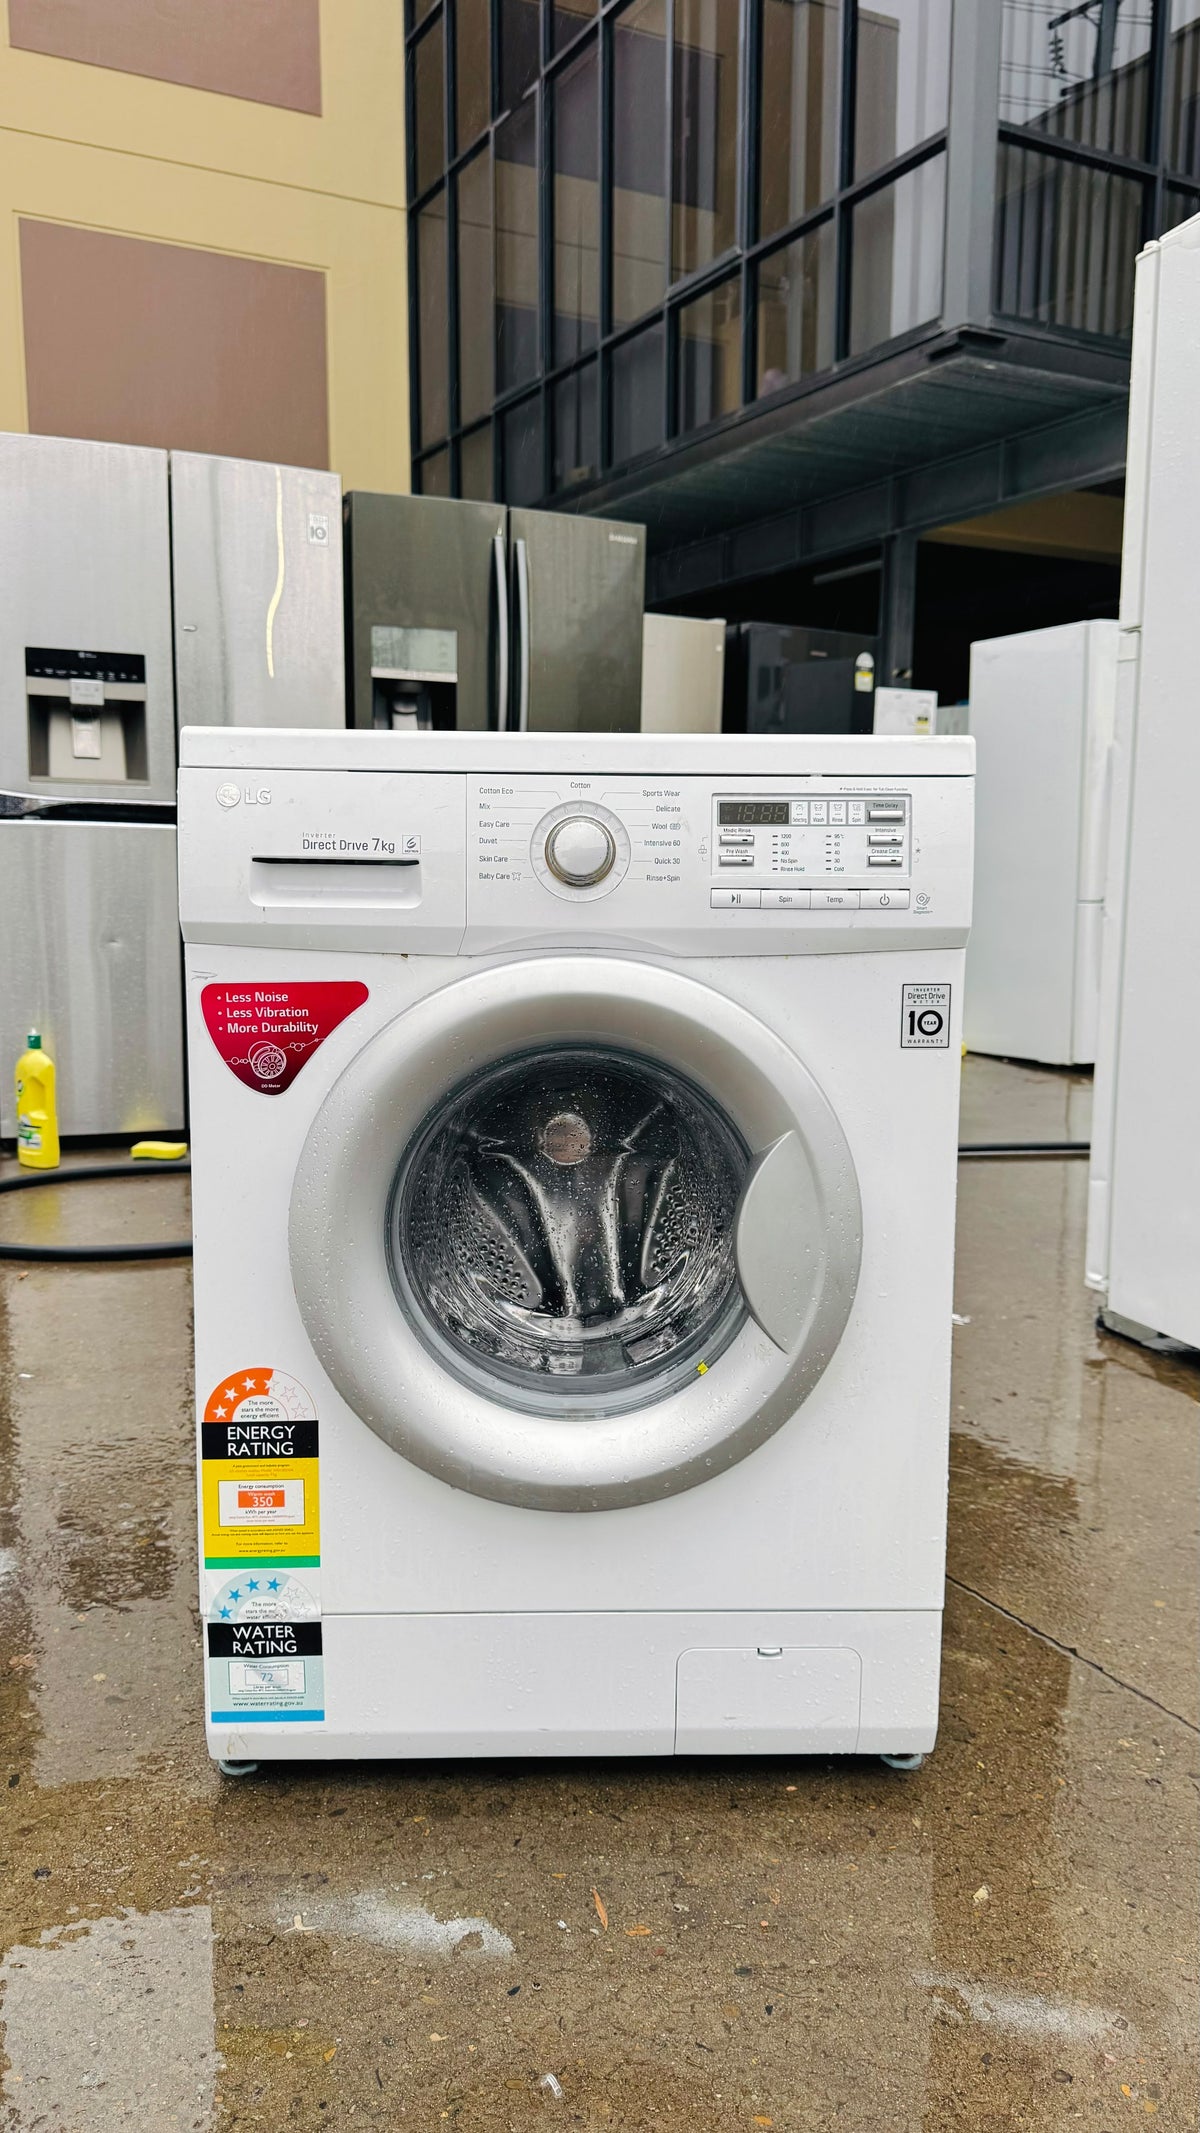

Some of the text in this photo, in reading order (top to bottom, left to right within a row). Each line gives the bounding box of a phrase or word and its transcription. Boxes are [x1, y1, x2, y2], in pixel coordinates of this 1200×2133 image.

[245, 787, 271, 805] LG
[479, 787, 514, 795] Cotton Eco
[302, 839, 336, 850] Direct
[340, 839, 369, 850] Drive
[779, 895, 793, 903] Spin
[827, 896, 844, 904] Temp
[226, 992, 288, 1003] Less Noise
[226, 1007, 309, 1018] Less Vibration
[227, 1022, 319, 1034] More Durability
[908, 1010, 944, 1036] 10
[227, 1425, 296, 1440] ENERGY
[227, 1442, 294, 1456] RATING
[252, 1496, 273, 1506] 350
[232, 1626, 295, 1640] WATER
[232, 1641, 297, 1655] RATING
[260, 1672, 274, 1682] 72
